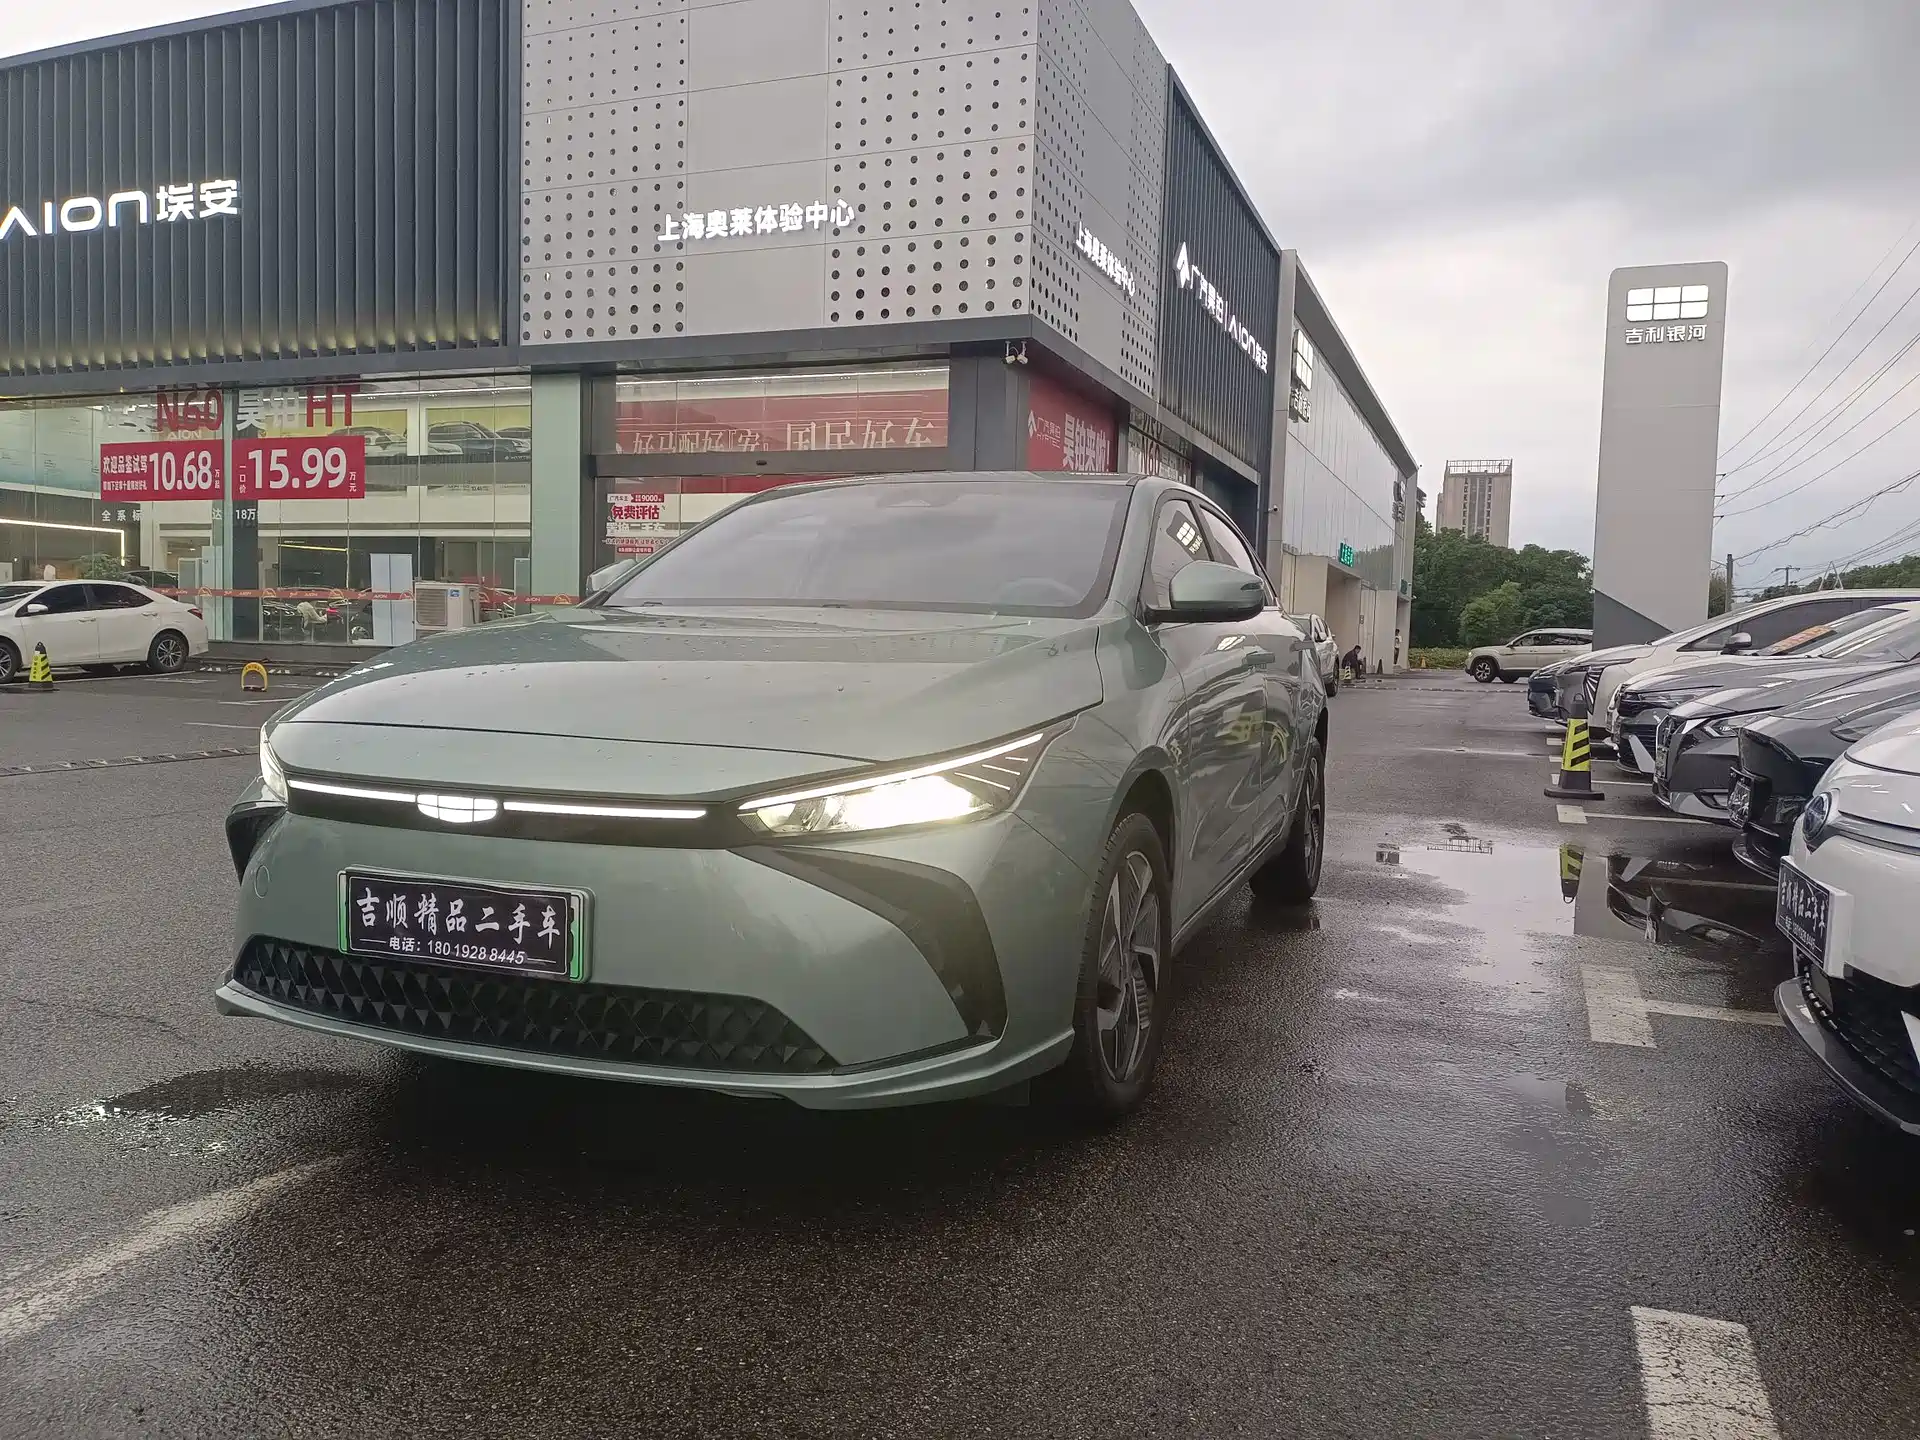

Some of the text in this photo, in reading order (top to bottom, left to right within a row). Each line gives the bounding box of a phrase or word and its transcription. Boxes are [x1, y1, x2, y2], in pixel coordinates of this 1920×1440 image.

[0, 179, 238, 239] AION 埃安
[658, 199, 855, 241] 上海奥莱体验中心
[1625, 324, 1708, 345] 吉利银河
[102, 454, 148, 474] 欢迎品鉴试驾
[150, 451, 213, 491] 10.68
[239, 464, 247, 494] 一口价
[248, 446, 348, 489] 15.99
[348, 471, 357, 492] 万元
[611, 504, 660, 520] 免费评估
[356, 887, 561, 950] 吉顺精品二手车
[427, 939, 451, 957] 180
[454, 943, 487, 961] 1928
[489, 947, 526, 965] 8445
